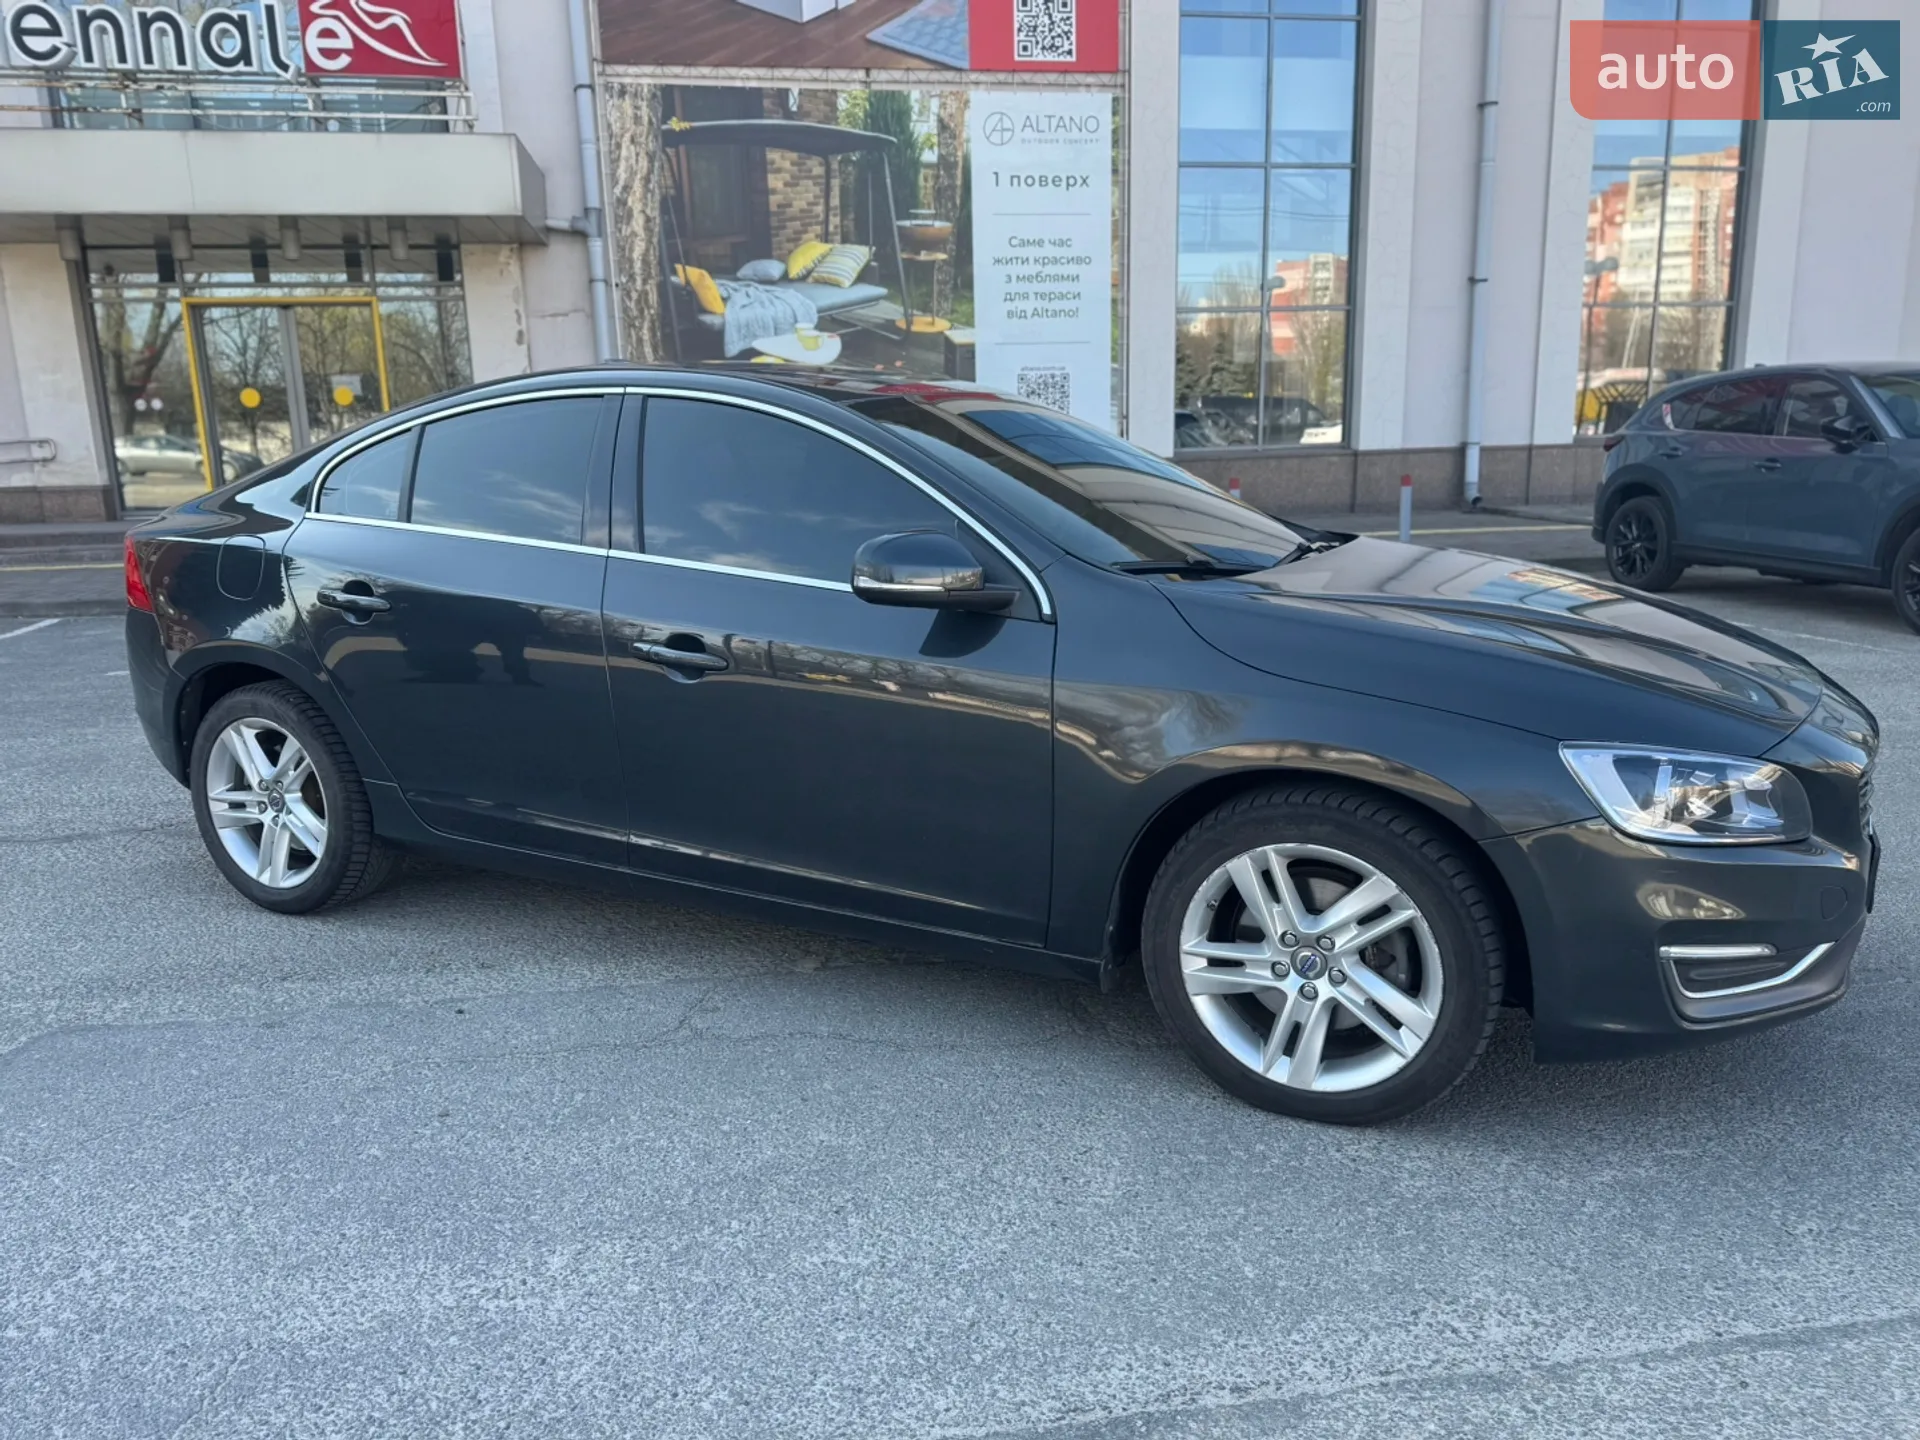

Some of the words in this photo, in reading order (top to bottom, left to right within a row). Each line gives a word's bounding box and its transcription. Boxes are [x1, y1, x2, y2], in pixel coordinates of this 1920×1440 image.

[1021, 115, 1100, 133] ALTANO
[992, 171, 1000, 188] 1
[1009, 173, 1091, 191] поверх
[1008, 236, 1045, 248] Саме
[1048, 237, 1073, 248] час
[992, 255, 1030, 266] жити
[1033, 255, 1092, 268] красиво
[1004, 273, 1012, 284] з
[1015, 270, 1081, 284] меблями
[1003, 290, 1030, 303] для
[1033, 291, 1081, 303] тераси
[1006, 306, 1028, 319] від
[1030, 306, 1080, 319] Altano!
